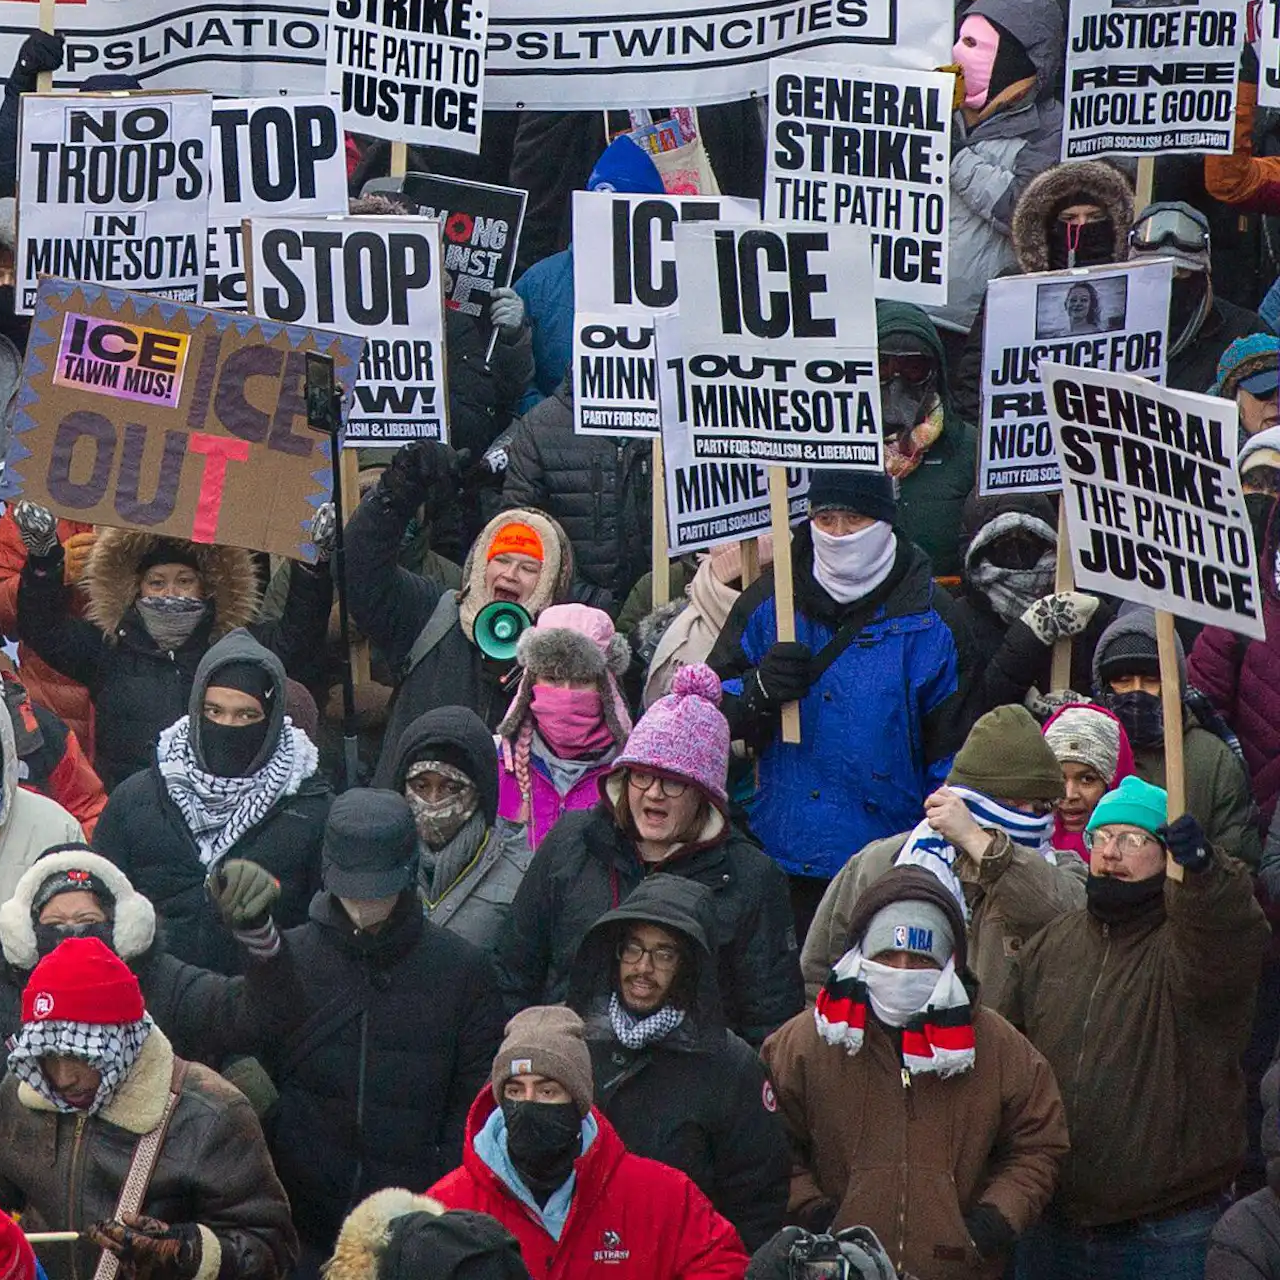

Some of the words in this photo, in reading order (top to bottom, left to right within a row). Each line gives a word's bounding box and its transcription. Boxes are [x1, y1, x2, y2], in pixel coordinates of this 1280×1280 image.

[333, 24, 378, 68] THE
[381, 31, 441, 76] PATH
[446, 43, 480, 88] TO
[1072, 11, 1181, 53] JUSTICE
[1183, 10, 1238, 47] FOR
[340, 70, 478, 137] JUSTICE
[775, 74, 946, 133] GENERAL
[1071, 61, 1236, 93] RENEE
[69, 106, 170, 142] NO
[1069, 91, 1158, 132] NICOLE
[1161, 89, 1234, 126] GOOD
[31, 139, 205, 205] TROOPS
[774, 119, 945, 187] STRIKE:
[93, 215, 137, 238] IN
[775, 176, 827, 224] THE
[833, 181, 902, 232] PATH
[907, 192, 944, 237] TO
[26, 234, 201, 283] MINNESOTA
[261, 227, 432, 327] STOP
[715, 228, 838, 343] ICE
[69, 319, 182, 374] ICE
[687, 353, 798, 384] OUT
[803, 359, 874, 386] OF
[1111, 329, 1164, 383] FOR
[63, 356, 120, 392] TAWM
[123, 366, 175, 401] MUS!
[186, 333, 314, 458] ICE
[690, 384, 877, 437] MINNESOTA
[1052, 380, 1233, 469] GENERAL
[46, 410, 250, 545] OUT
[695, 437, 729, 457] PARTY
[751, 440, 802, 459] SOCIALISM
[817, 443, 876, 462] LIBERATION
[1060, 425, 1243, 520] STRIKE:
[1070, 480, 1129, 533] THE
[1134, 494, 1208, 557] PATH
[1218, 518, 1252, 571] TO
[1078, 530, 1260, 624] JUSTICE
[907, 925, 934, 953] NBA
